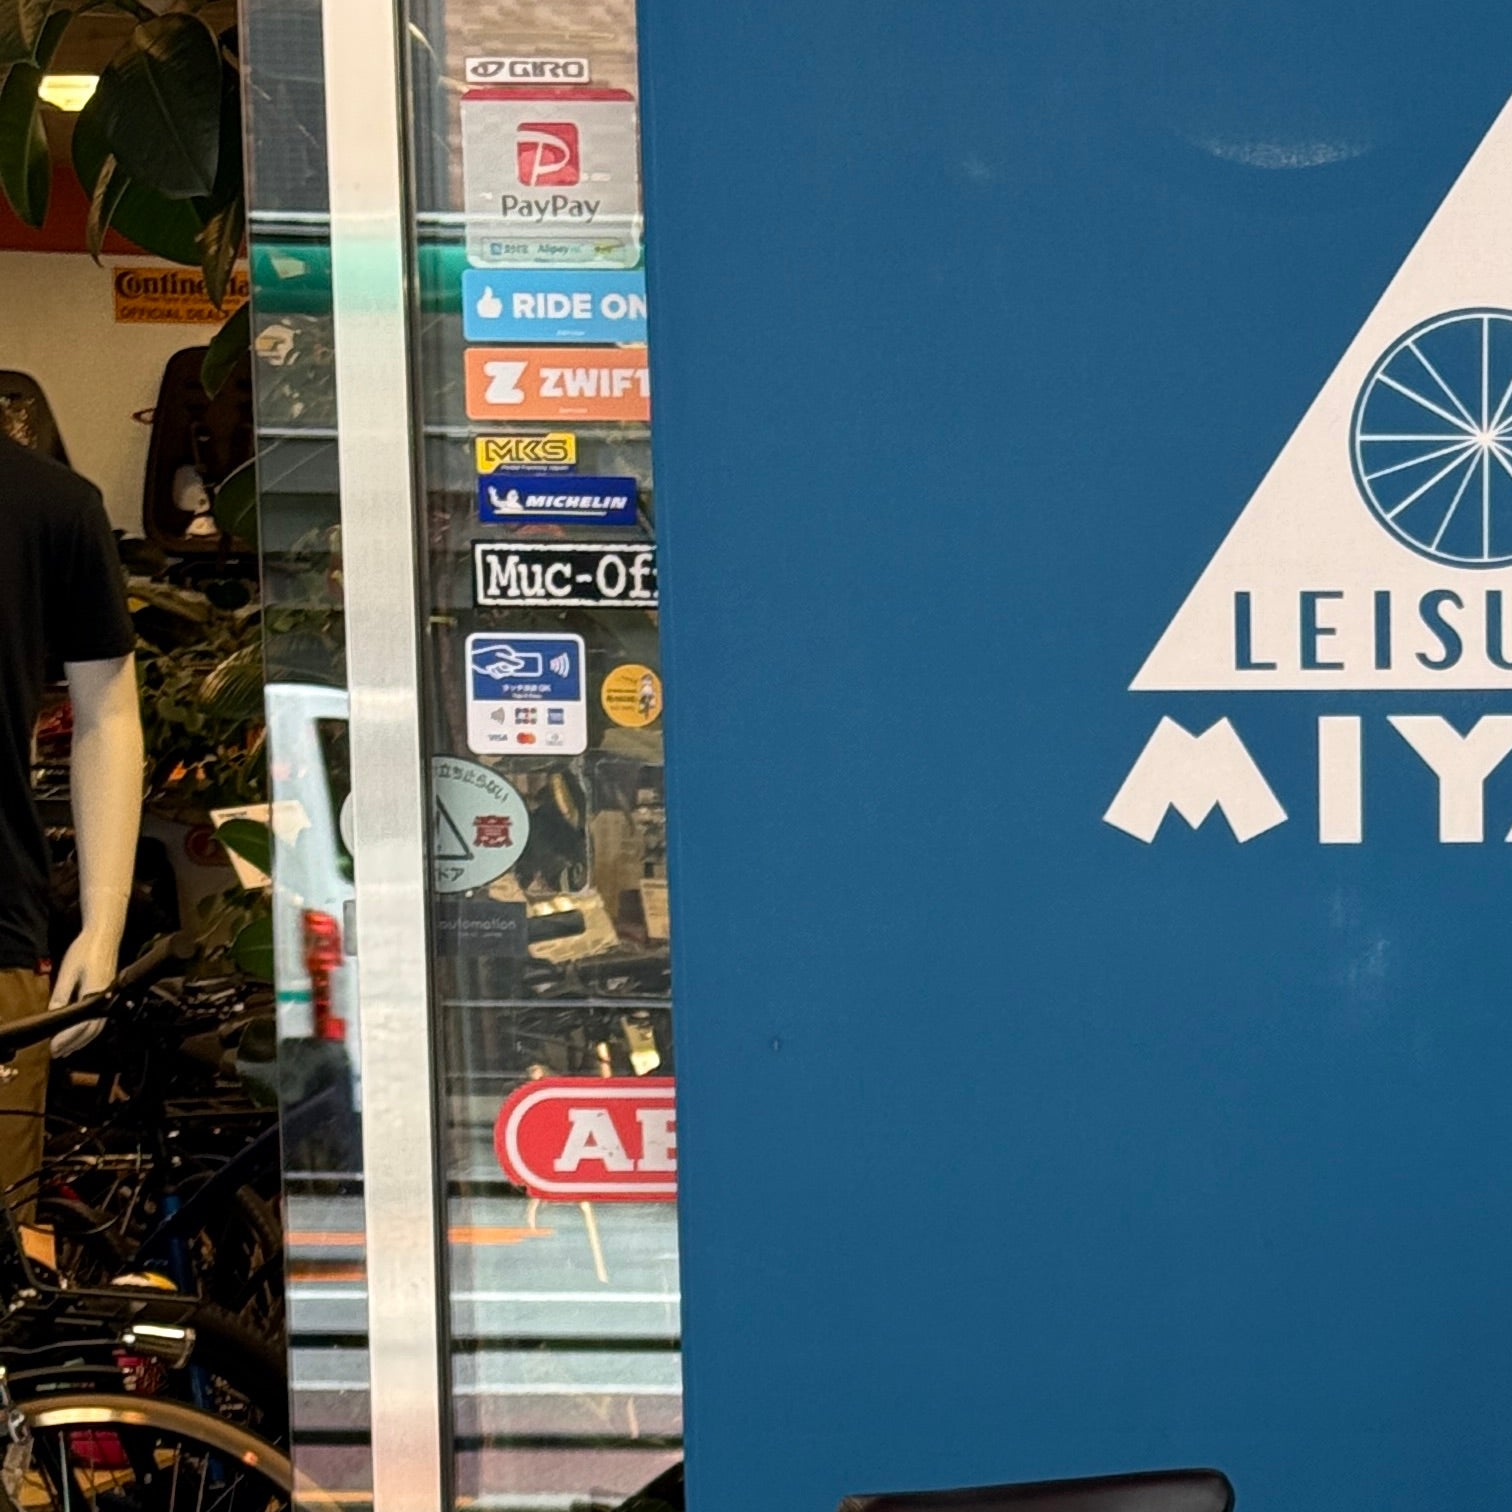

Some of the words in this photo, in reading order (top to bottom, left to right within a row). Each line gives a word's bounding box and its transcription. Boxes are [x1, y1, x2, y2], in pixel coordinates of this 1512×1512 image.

[509, 61, 584, 78] GIRO
[502, 195, 600, 223] PayPay
[513, 293, 592, 319] RIDE
[485, 440, 568, 462] MKS
[525, 495, 628, 510] MICHELIN
[486, 554, 659, 598] Muc-Of
